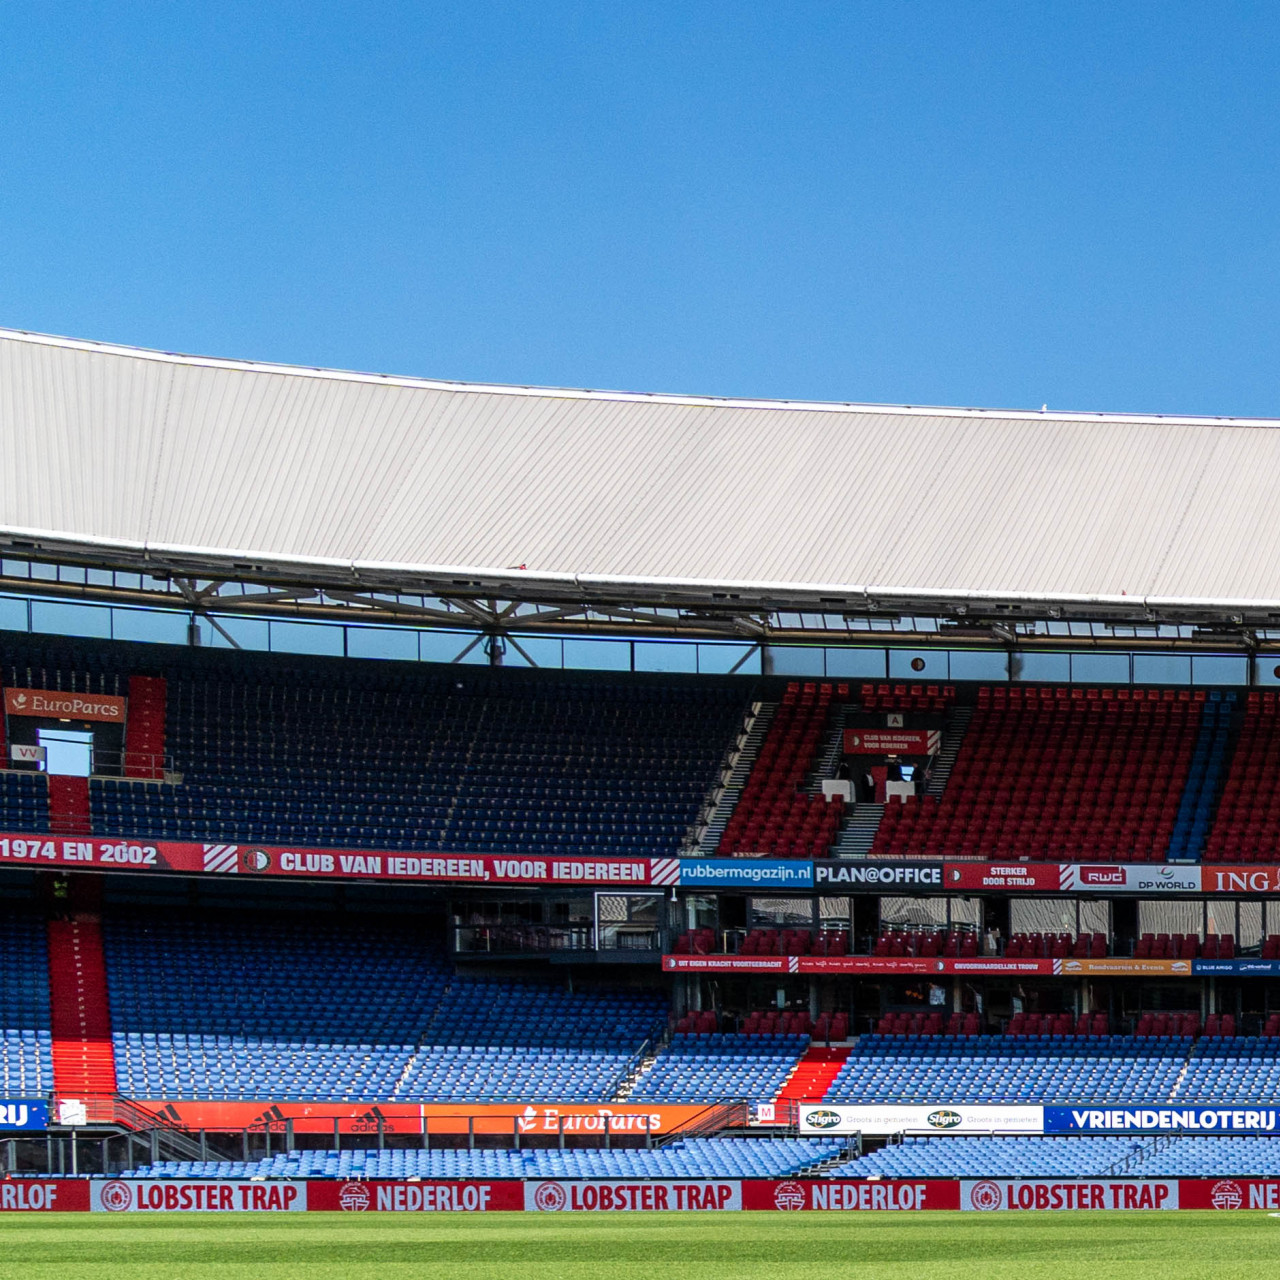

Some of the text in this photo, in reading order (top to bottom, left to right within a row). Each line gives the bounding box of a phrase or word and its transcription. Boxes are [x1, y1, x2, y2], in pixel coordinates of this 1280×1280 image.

[32, 695, 119, 717] EuroParcs
[19, 748, 37, 758] VV
[0, 838, 157, 864] 1974 EN 2002
[280, 852, 644, 881] CLUB VAN IEDEREEN, VOOR IEDEREEN
[682, 866, 811, 882] rubbermagazijn.nl
[990, 868, 1026, 876] STERKER
[816, 868, 941, 883] PLAN@OFFICE
[983, 877, 1035, 886] DOOR STRIJD
[1088, 872, 1122, 882] RWG
[1216, 872, 1270, 891] ING
[1138, 881, 1196, 890] DP WORLD
[543, 1109, 661, 1130] EuroParcs
[762, 1108, 771, 1118] M
[806, 1112, 842, 1128] Sligro
[846, 1116, 918, 1126] Groots in genieten
[927, 1112, 963, 1128] Sligro
[967, 1116, 1038, 1126] Groots in genieten
[1072, 1111, 1276, 1130] VRIENDENLOTERIJ
[351, 1122, 395, 1133] adidas
[2, 1184, 58, 1210] RLOF
[137, 1184, 297, 1210] LOBSTER TRAP
[376, 1185, 492, 1210] NEDERLOF
[571, 1184, 732, 1210] LOBSTER TRAP
[812, 1184, 926, 1210] NEDERLOF
[1007, 1184, 1169, 1210] LOBSTER TRAP
